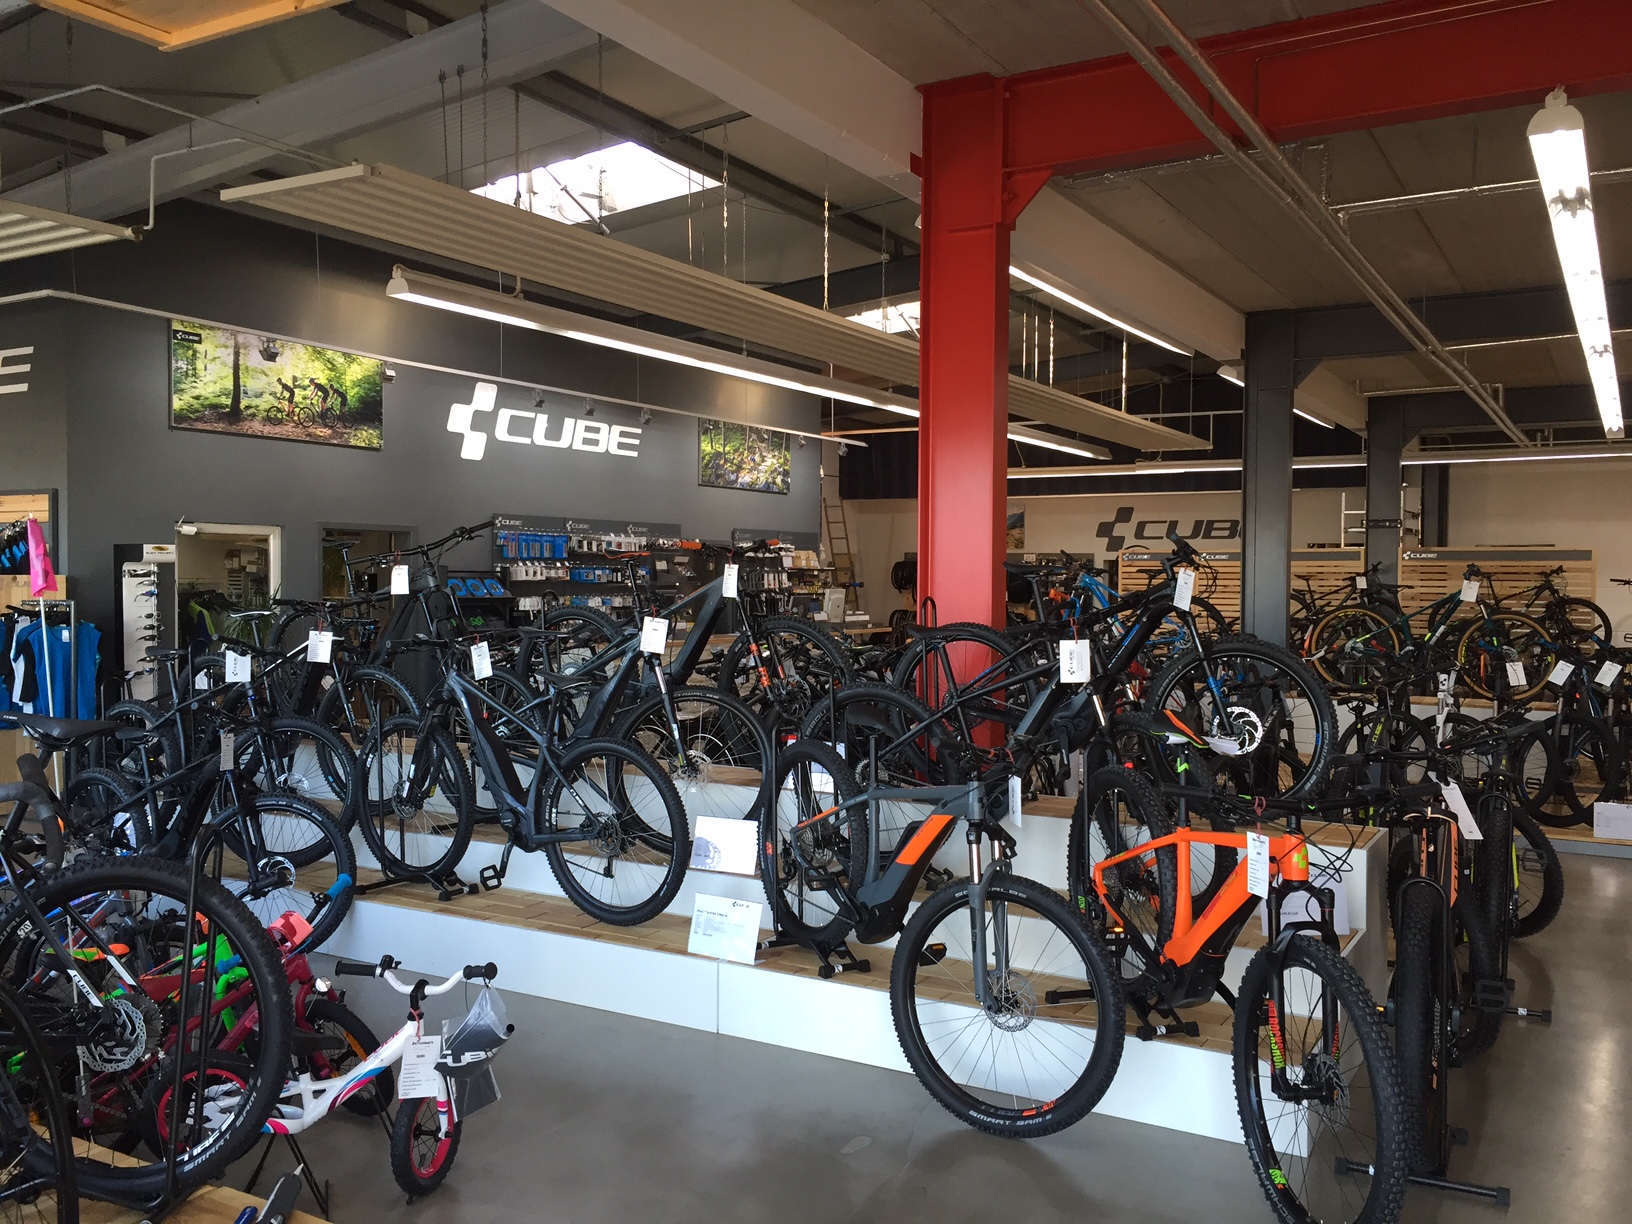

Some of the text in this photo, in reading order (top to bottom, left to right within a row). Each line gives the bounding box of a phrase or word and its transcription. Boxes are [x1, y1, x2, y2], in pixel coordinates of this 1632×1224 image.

[494, 407, 643, 458] CUBE
[501, 518, 523, 526] CUBE
[1134, 519, 1242, 540] CUB
[1304, 721, 1330, 790] SCHWALBE
[954, 887, 1027, 898] SCALBE
[968, 1109, 1042, 1126] SMART SAM
[183, 1130, 232, 1173] SMART
[1248, 1138, 1296, 1224] SCHWALBE
